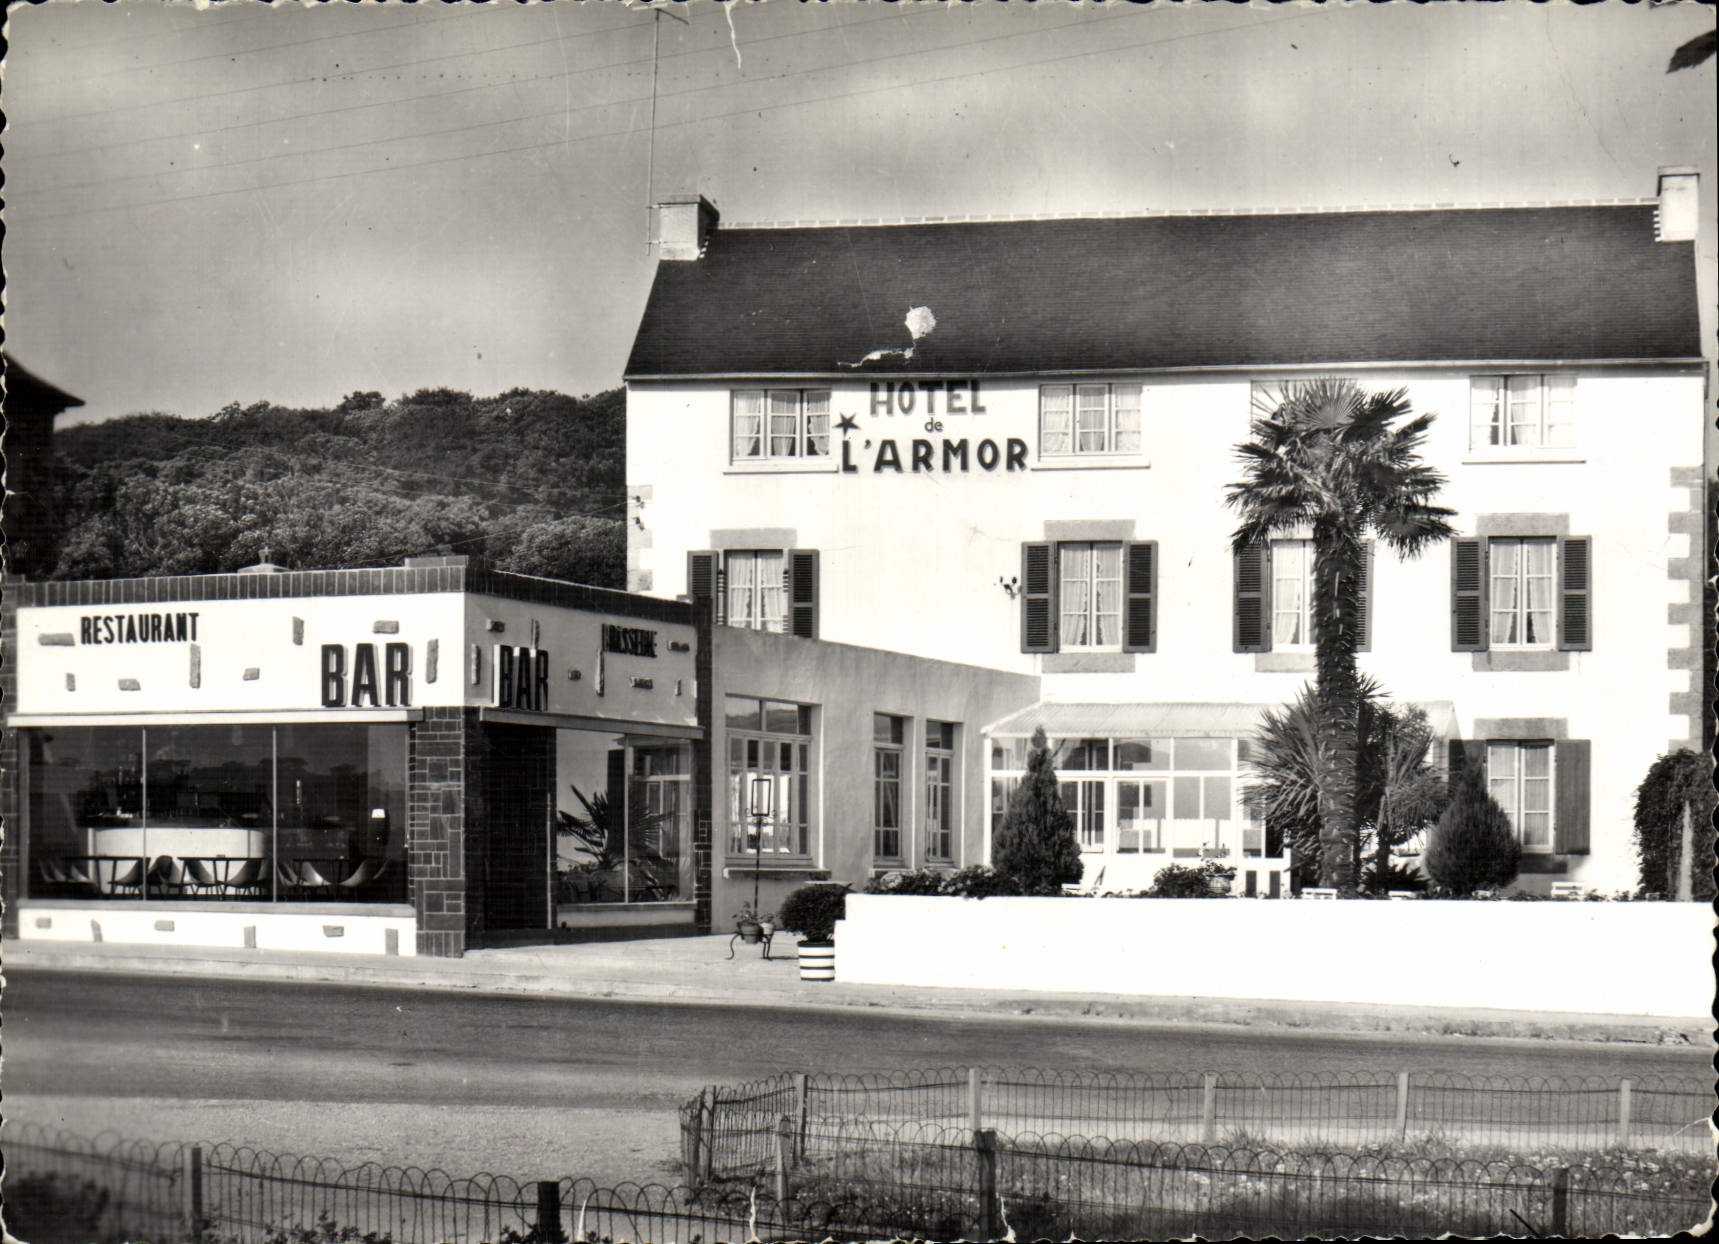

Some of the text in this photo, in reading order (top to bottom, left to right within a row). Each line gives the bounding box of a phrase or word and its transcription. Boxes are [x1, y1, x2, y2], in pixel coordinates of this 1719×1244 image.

[870, 379, 987, 416] HOTEL
[924, 417, 944, 432] de
[842, 437, 1029, 473] L'ARMOR
[80, 612, 199, 645] RESTAURANT
[321, 642, 413, 707] BAR
[493, 644, 549, 711] BAR
